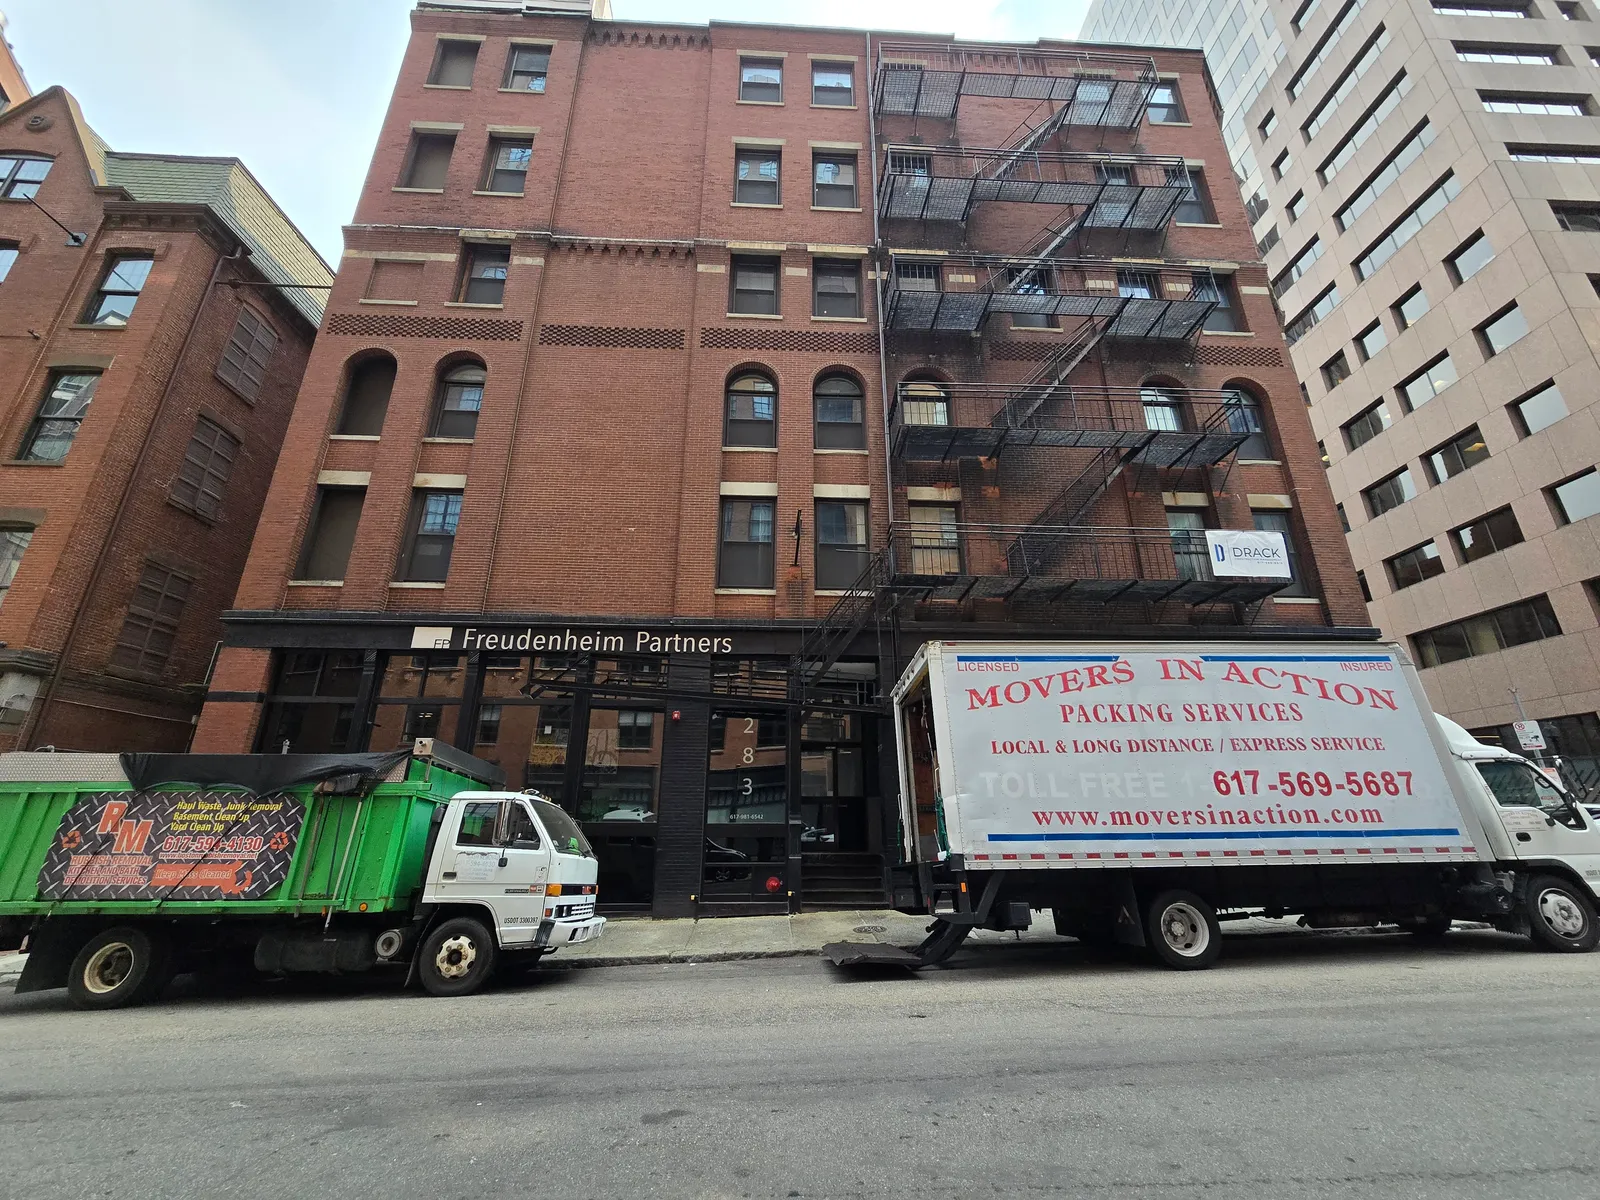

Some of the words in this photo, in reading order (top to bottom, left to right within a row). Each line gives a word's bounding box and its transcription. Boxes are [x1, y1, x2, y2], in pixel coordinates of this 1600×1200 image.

[1233, 547, 1281, 558] DRACK
[462, 627, 624, 651] Freudenheim
[636, 631, 733, 653] Partners
[957, 662, 1020, 672] LICENSED
[1340, 662, 1394, 672] INSURED
[965, 659, 1135, 711] MOVERS
[1155, 659, 1206, 681] IN
[1221, 661, 1399, 711] ACTION
[1060, 703, 1174, 723] PACKING
[1182, 702, 1304, 722] SERVICES
[991, 740, 1050, 754] LOCAL
[1055, 740, 1068, 754] &
[1072, 739, 1122, 753] LONG
[1126, 738, 1214, 753] DISTANCE
[1229, 737, 1307, 752] EXPRESS
[1312, 737, 1386, 751] SERVICE
[979, 772, 1069, 799] TOLL
[1079, 771, 1169, 799] FREE
[1213, 769, 1413, 797] 617-569-5687
[177, 801, 195, 810] Haul
[226, 802, 247, 810] Junk
[248, 802, 283, 811] emoval
[173, 812, 213, 820] Basement
[214, 813, 236, 821] Clean
[1032, 803, 1385, 826] www.moversinaction.com
[170, 822, 189, 831] Yard
[189, 822, 211, 831] Clean
[213, 823, 225, 832] Up
[162, 835, 264, 852] 617-594-4130
[70, 855, 109, 865] RUBBISH
[111, 855, 153, 866] REMOVAL
[67, 866, 99, 876] KITCHEN
[100, 866, 119, 876] AND
[120, 867, 140, 876] BATH
[63, 876, 110, 885] DEMOLITION
[111, 876, 148, 885] SERVICES
